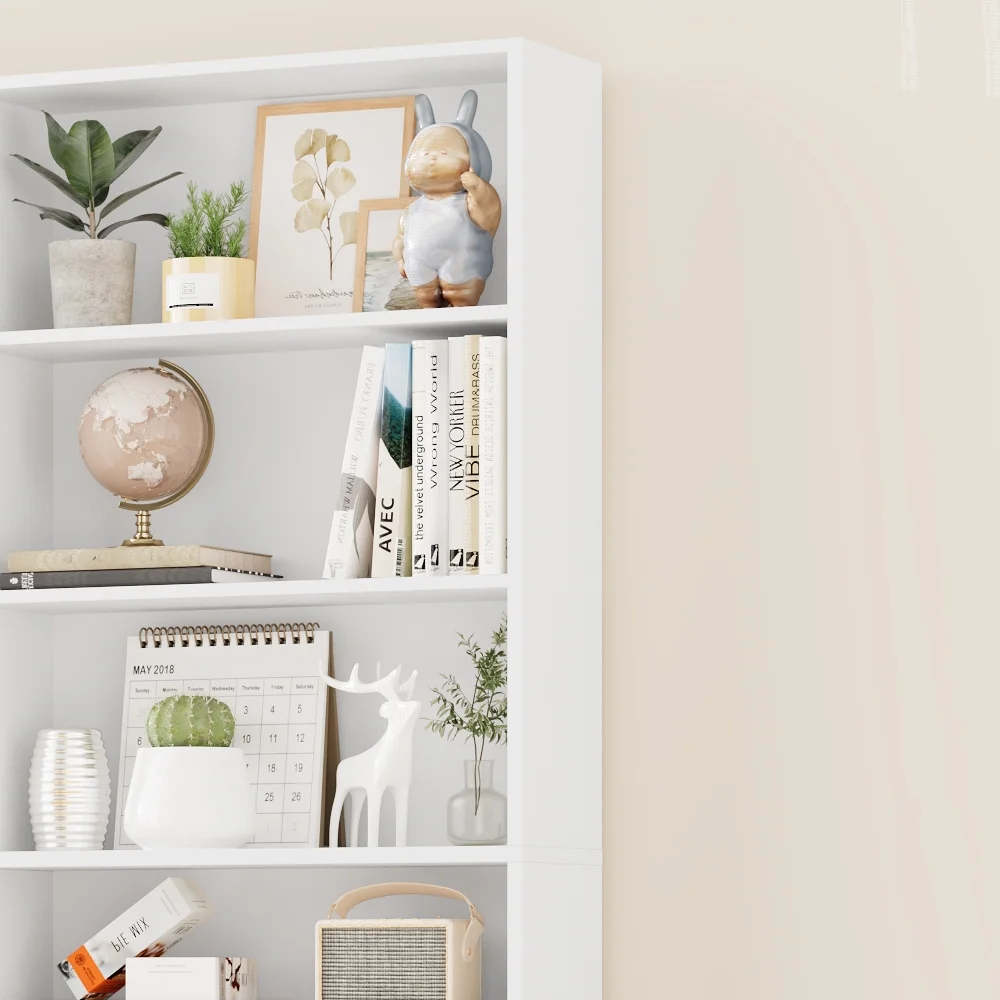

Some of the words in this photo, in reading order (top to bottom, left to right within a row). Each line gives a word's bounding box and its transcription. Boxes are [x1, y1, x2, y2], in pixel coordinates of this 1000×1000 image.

[430, 355, 438, 414] World
[449, 389, 465, 456] YORKER
[415, 415, 426, 484] underground
[430, 422, 439, 489] Wrong
[450, 456, 465, 492] NEW
[465, 445, 480, 501] VIBE
[415, 487, 424, 521] velvet
[379, 498, 395, 553] AVEC
[415, 523, 424, 541] the
[133, 665, 151, 675] MAY
[154, 665, 175, 674] 2018
[244, 706, 249, 715] 3
[270, 705, 276, 714] 4
[297, 704, 302, 714] 5
[137, 737, 142, 746] 6
[242, 734, 251, 744] 10
[269, 734, 277, 743] 11
[296, 734, 305, 743] 12
[267, 764, 276, 773] 18
[294, 764, 303, 773] 19
[264, 793, 274, 802] 25
[292, 792, 301, 802] 26
